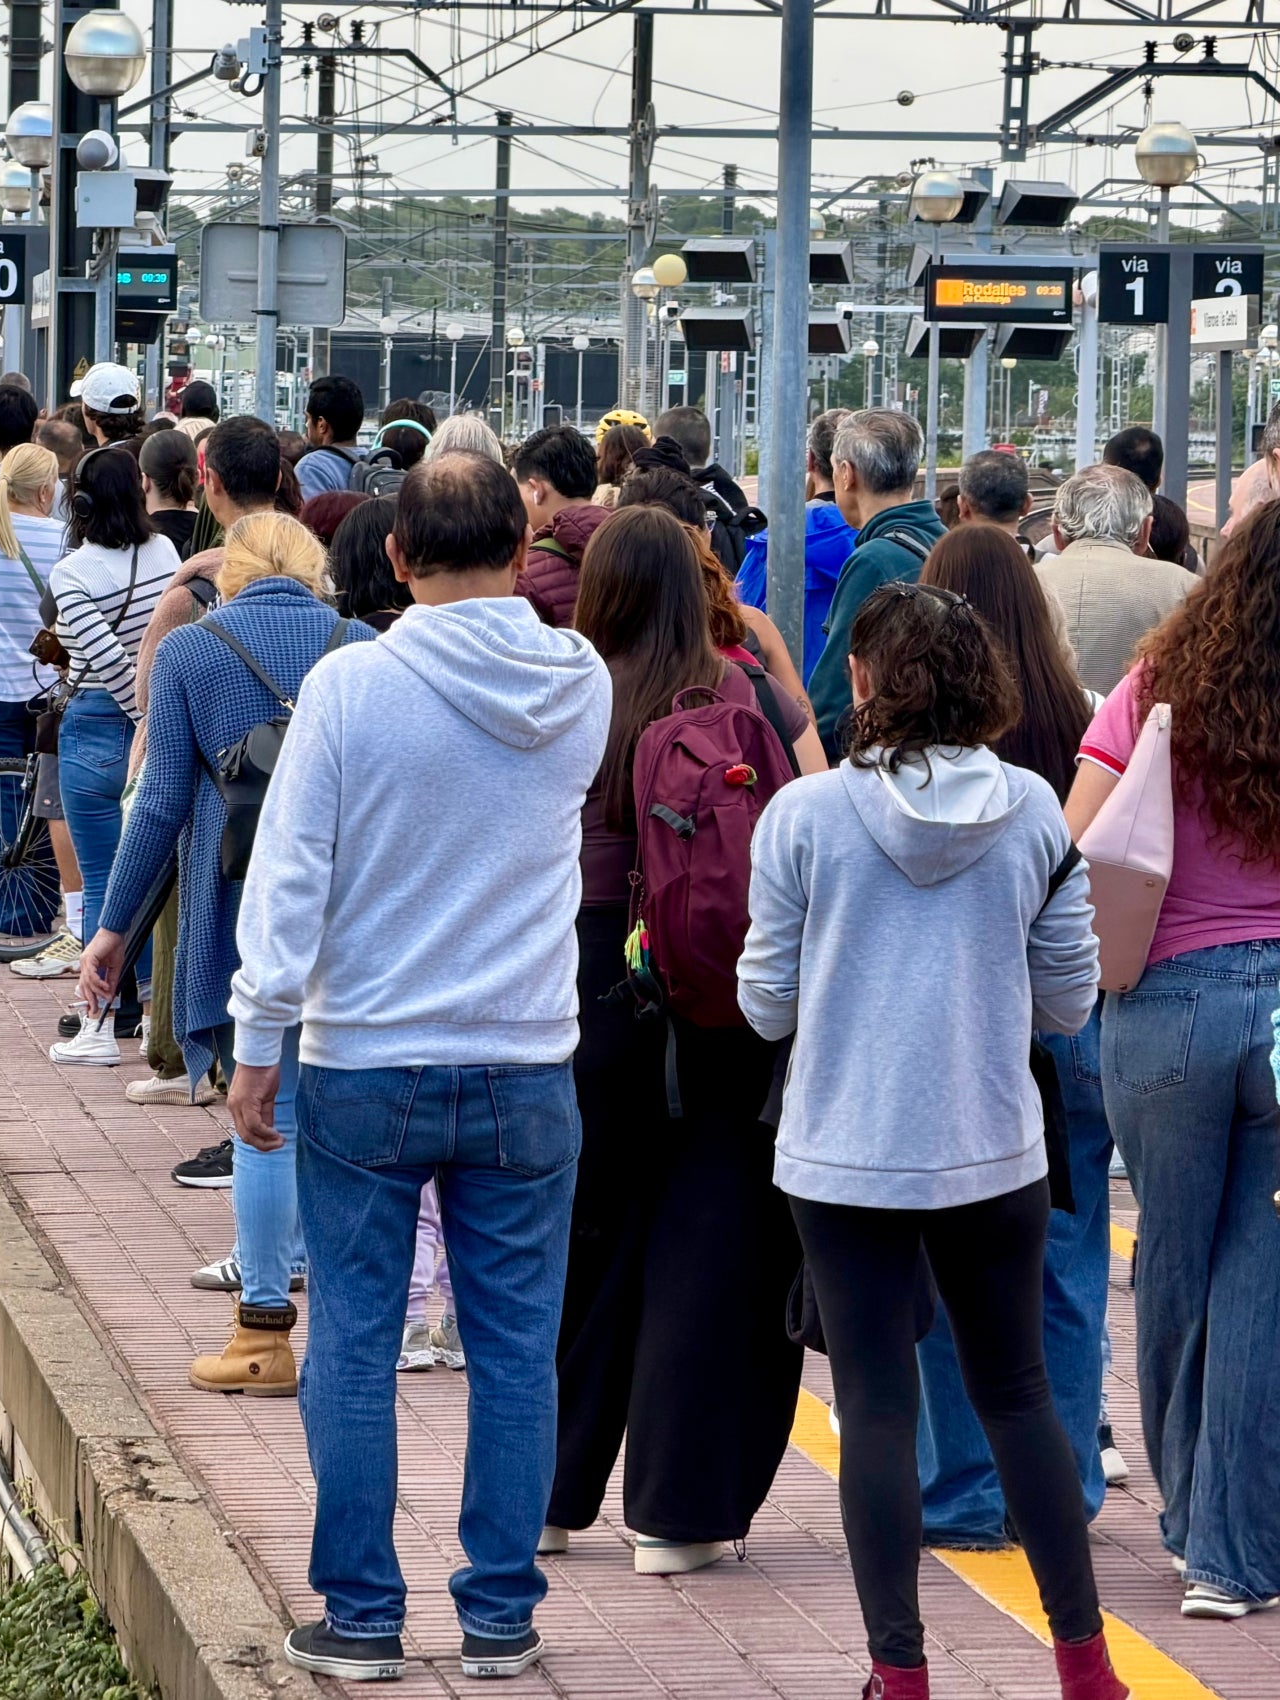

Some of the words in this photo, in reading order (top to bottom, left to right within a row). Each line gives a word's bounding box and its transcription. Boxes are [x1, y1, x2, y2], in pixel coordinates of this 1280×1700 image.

[1121, 255, 1150, 273] via
[1215, 256, 1243, 274] via
[963, 282, 1027, 297] Rodalies
[1125, 276, 1144, 316] 1
